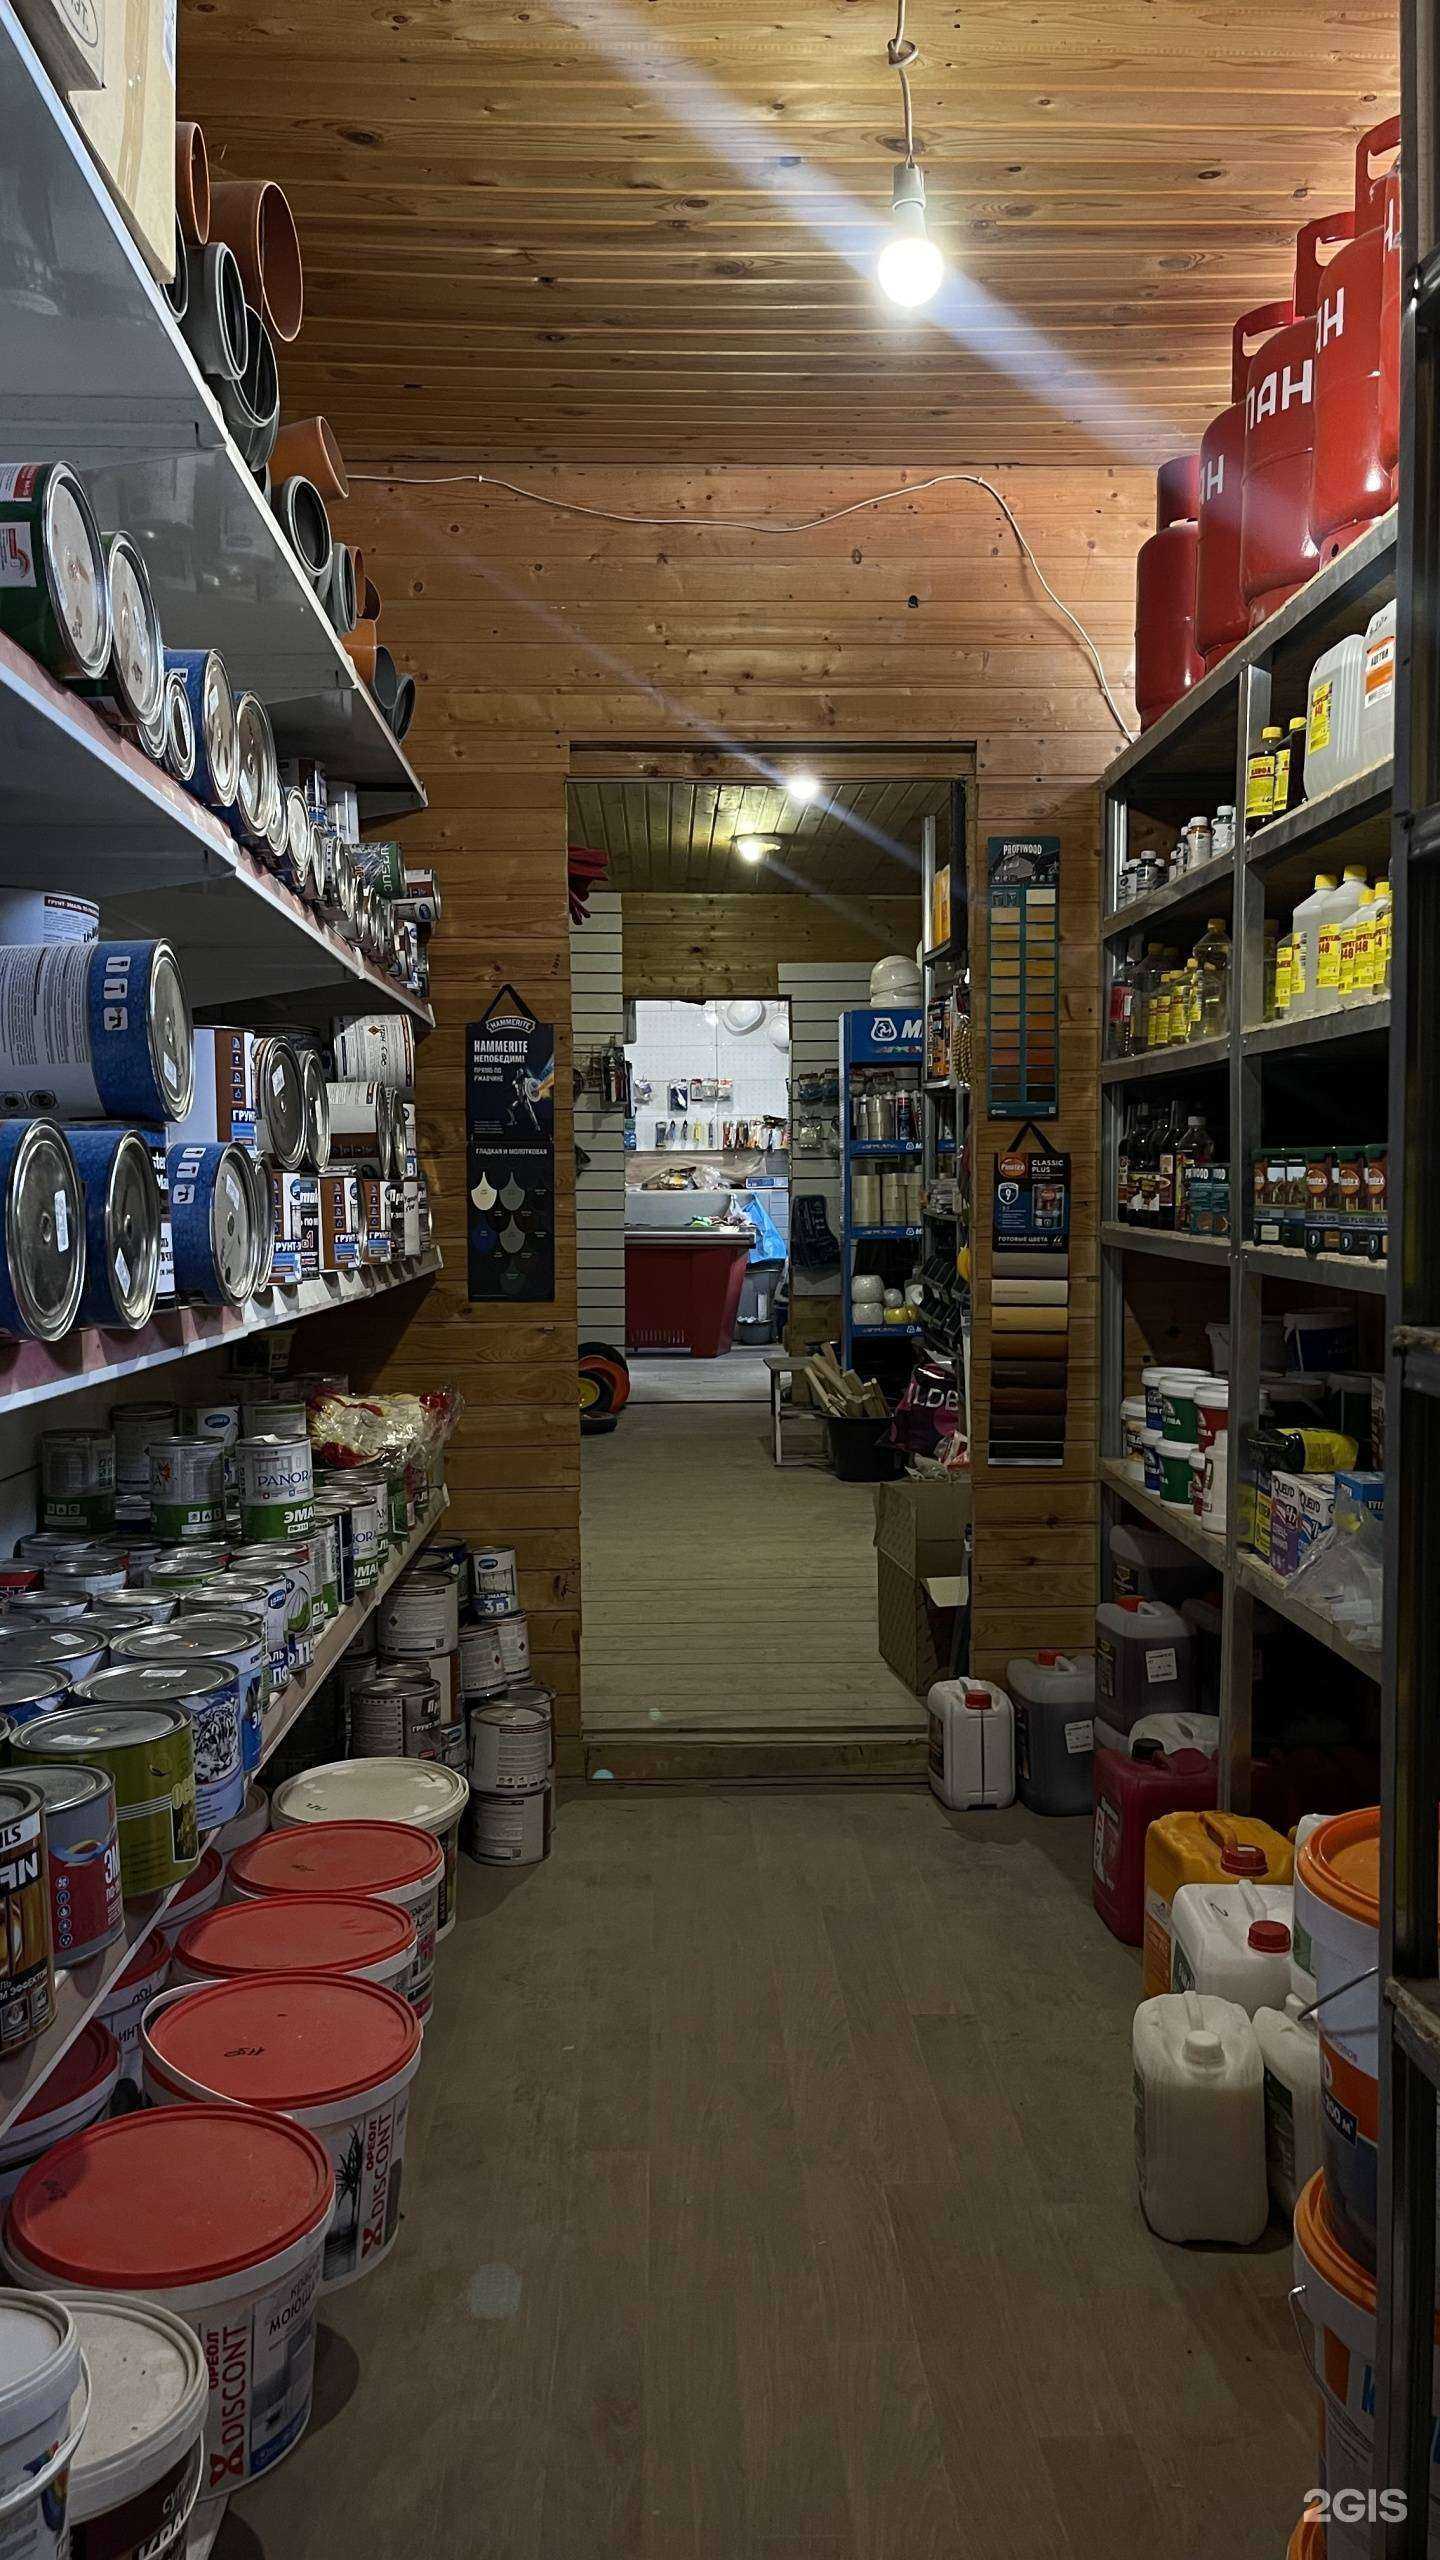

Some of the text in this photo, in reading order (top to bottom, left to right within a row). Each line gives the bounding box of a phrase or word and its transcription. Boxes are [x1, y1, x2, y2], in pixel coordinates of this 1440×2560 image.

[490, 1018, 531, 1031] HAMMERITE
[474, 1041, 528, 1053] HAMMERITE
[1005, 1188, 1012, 1201] 9
[371, 2114, 391, 2219] DISCONT
[222, 2326, 247, 2445] DISCONT
